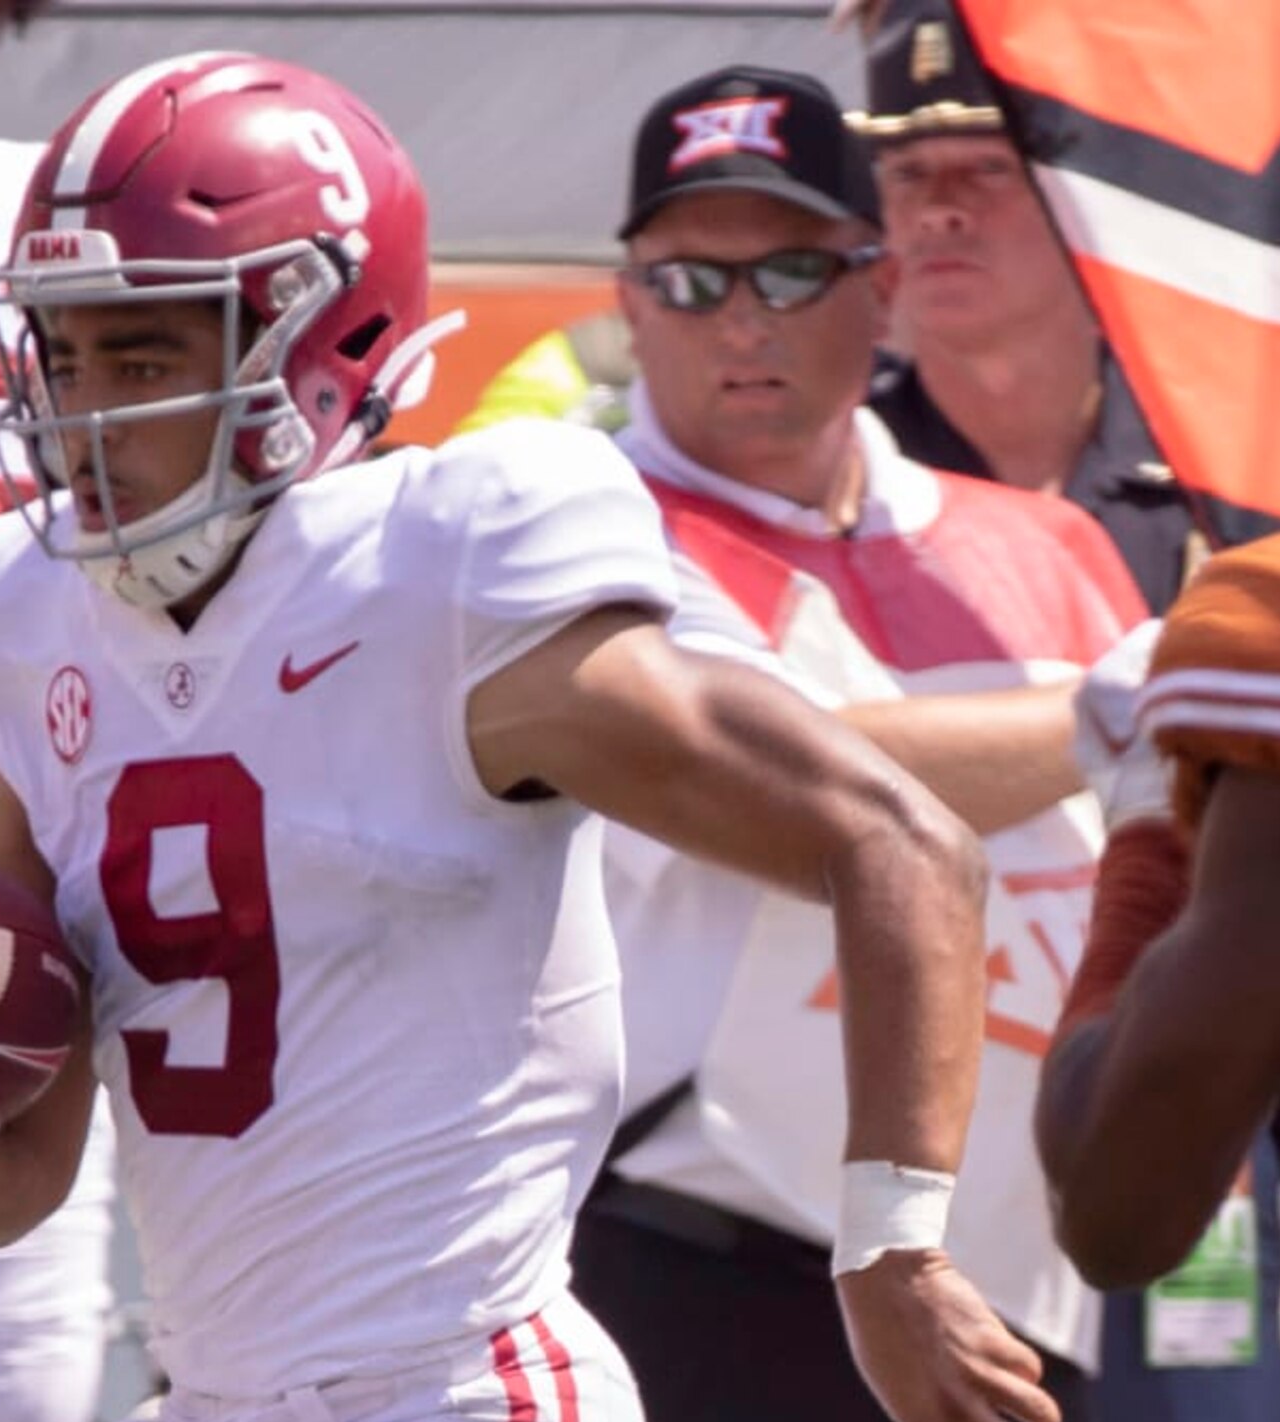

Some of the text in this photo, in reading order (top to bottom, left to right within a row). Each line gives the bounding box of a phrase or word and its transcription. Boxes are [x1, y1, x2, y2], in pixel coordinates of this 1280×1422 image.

[292, 109, 371, 225] 9
[27, 236, 81, 262] BAMA
[51, 672, 89, 756] SEC
[99, 752, 281, 1139] 9
